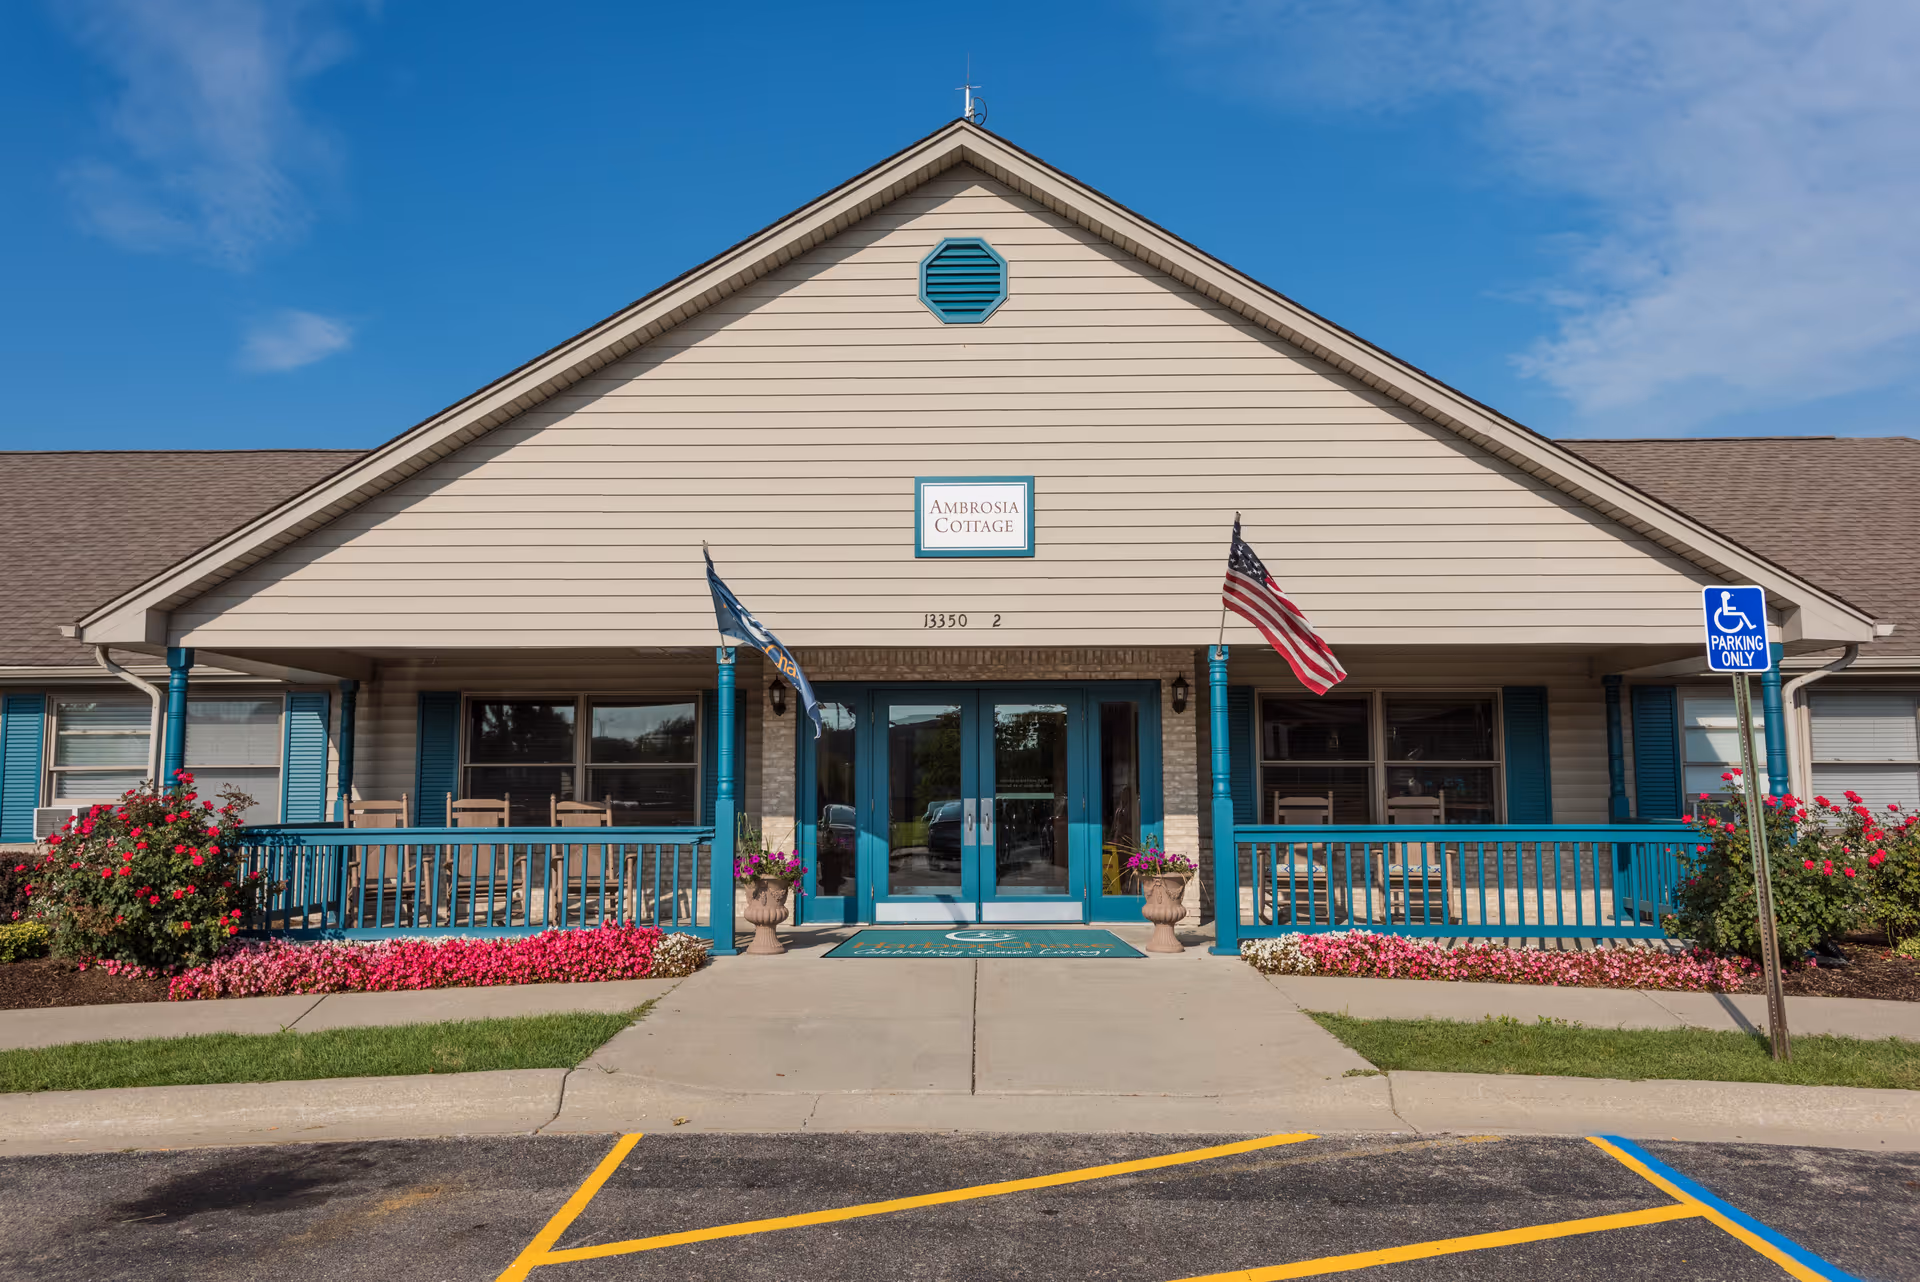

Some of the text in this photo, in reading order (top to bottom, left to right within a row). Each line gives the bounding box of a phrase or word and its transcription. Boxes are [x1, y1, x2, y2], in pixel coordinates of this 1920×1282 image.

[928, 499, 1020, 514] AMBROSIA
[934, 517, 1014, 533] COTTAGE
[924, 613, 1001, 628] 13350 2
[1711, 635, 1764, 651] PARKING
[1721, 651, 1755, 667] ONLY
[853, 941, 1116, 949] HarborChase
